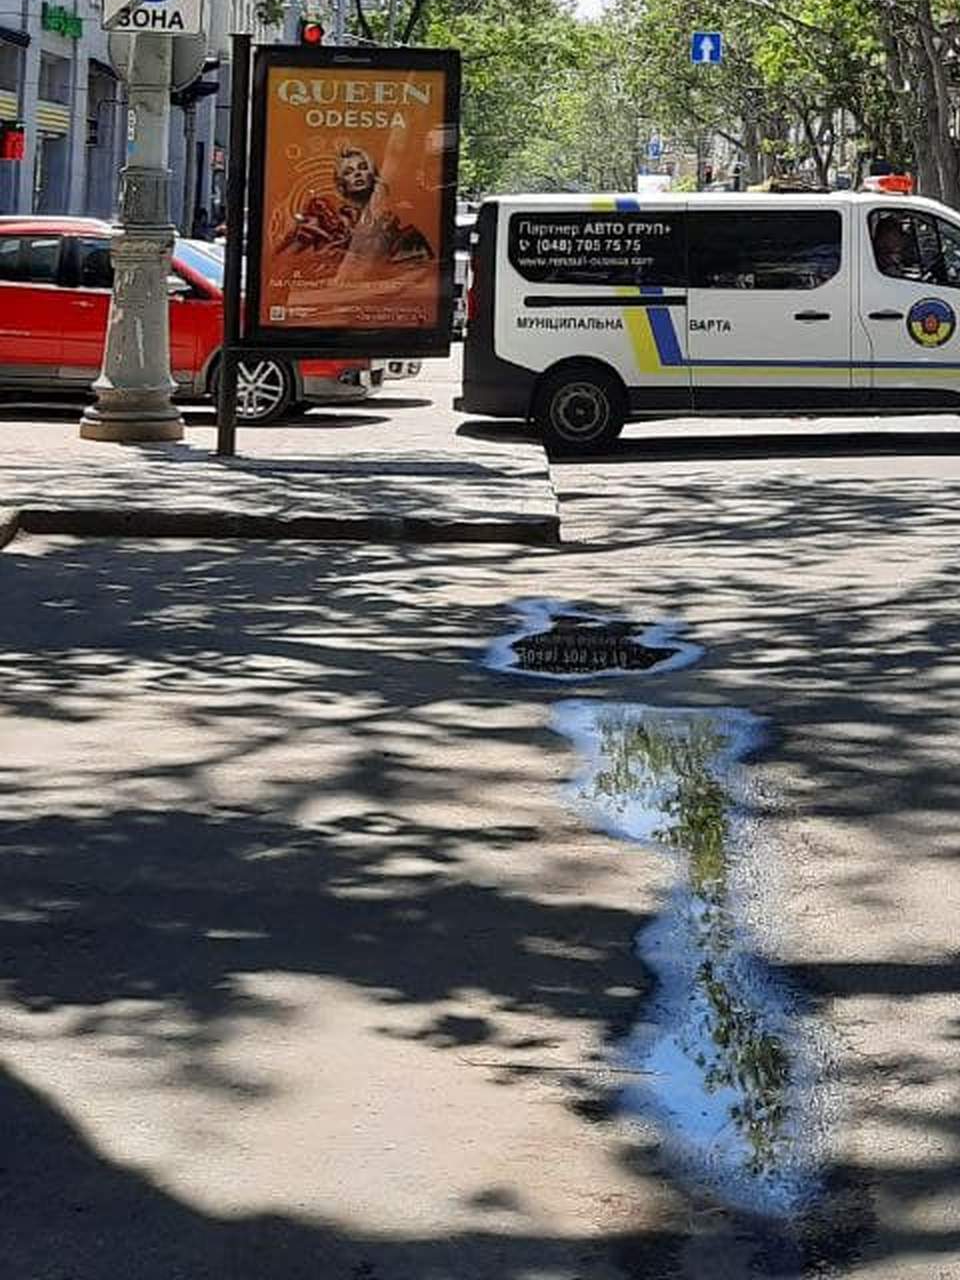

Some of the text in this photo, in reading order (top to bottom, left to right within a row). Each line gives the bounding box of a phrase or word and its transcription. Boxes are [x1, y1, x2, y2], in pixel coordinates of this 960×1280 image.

[119, 8, 184, 30] ЗОНА
[277, 79, 432, 106] QUEEN
[305, 109, 406, 129] ODESSA
[584, 223, 624, 235] АВТО
[576, 239, 601, 252] 705
[604, 239, 621, 252] 75
[625, 239, 641, 252] 75
[517, 317, 732, 331] МУНІЦИПАЛЬНА ВАРТА
